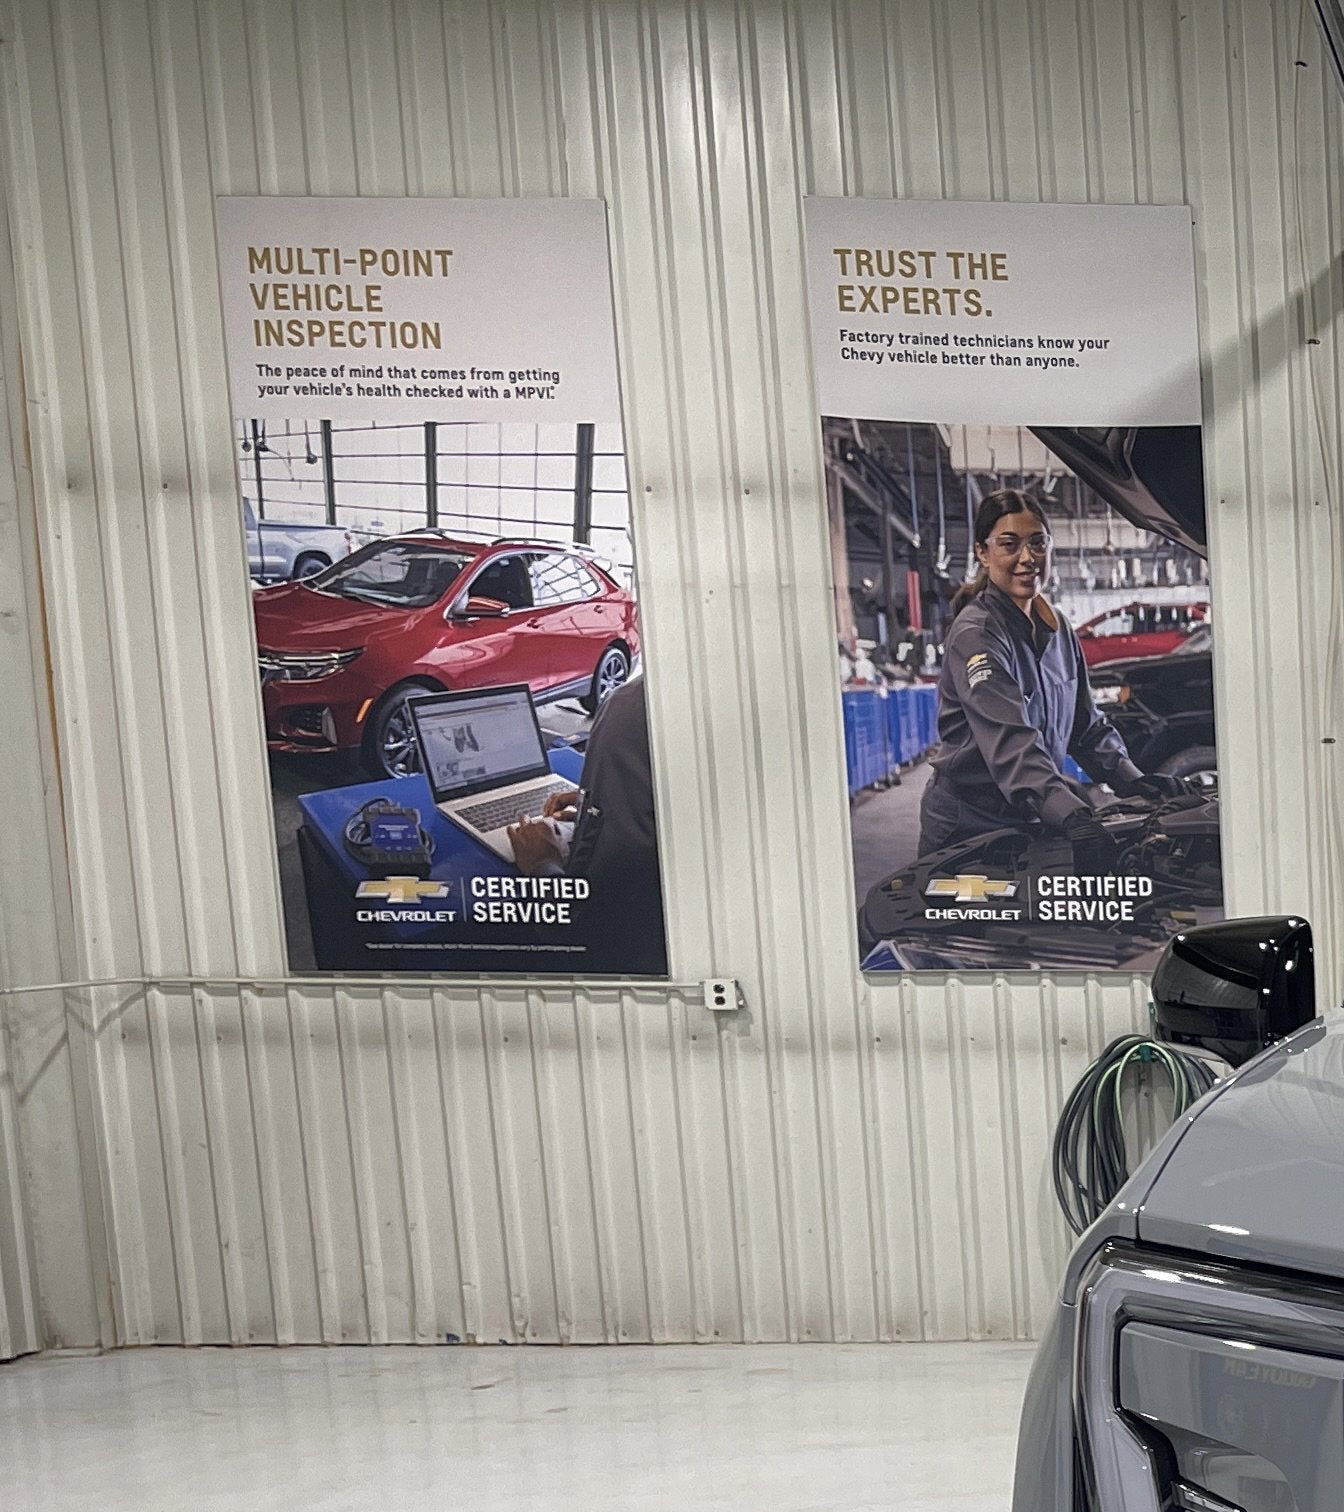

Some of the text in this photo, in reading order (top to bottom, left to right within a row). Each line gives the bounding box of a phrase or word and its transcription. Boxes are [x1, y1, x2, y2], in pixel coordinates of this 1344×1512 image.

[247, 246, 453, 277] MULTI-POINT
[833, 248, 1009, 281] TRUST THE
[250, 283, 383, 312] VEHICLE
[837, 284, 993, 318] EXPERTS.
[253, 319, 442, 349] INSPECTION
[839, 329, 1110, 351] Factory trained technicians know your
[841, 347, 1080, 369] Chevy vehicle better than anyone.
[256, 364, 560, 384] The peace of mind that comes from getting
[258, 385, 289, 398] your
[293, 382, 353, 396] vehicle's
[357, 383, 401, 397] health
[405, 385, 463, 398] checked
[466, 385, 499, 399] with
[503, 389, 511, 399] a
[471, 875, 589, 899] CERTIFIED
[1037, 875, 1153, 897] CERTIFIED
[356, 909, 457, 924] CHEVROLET
[473, 902, 571, 924] SERVICE
[925, 909, 1022, 921] CHEVROLET
[1038, 900, 1134, 921] SERVICE
